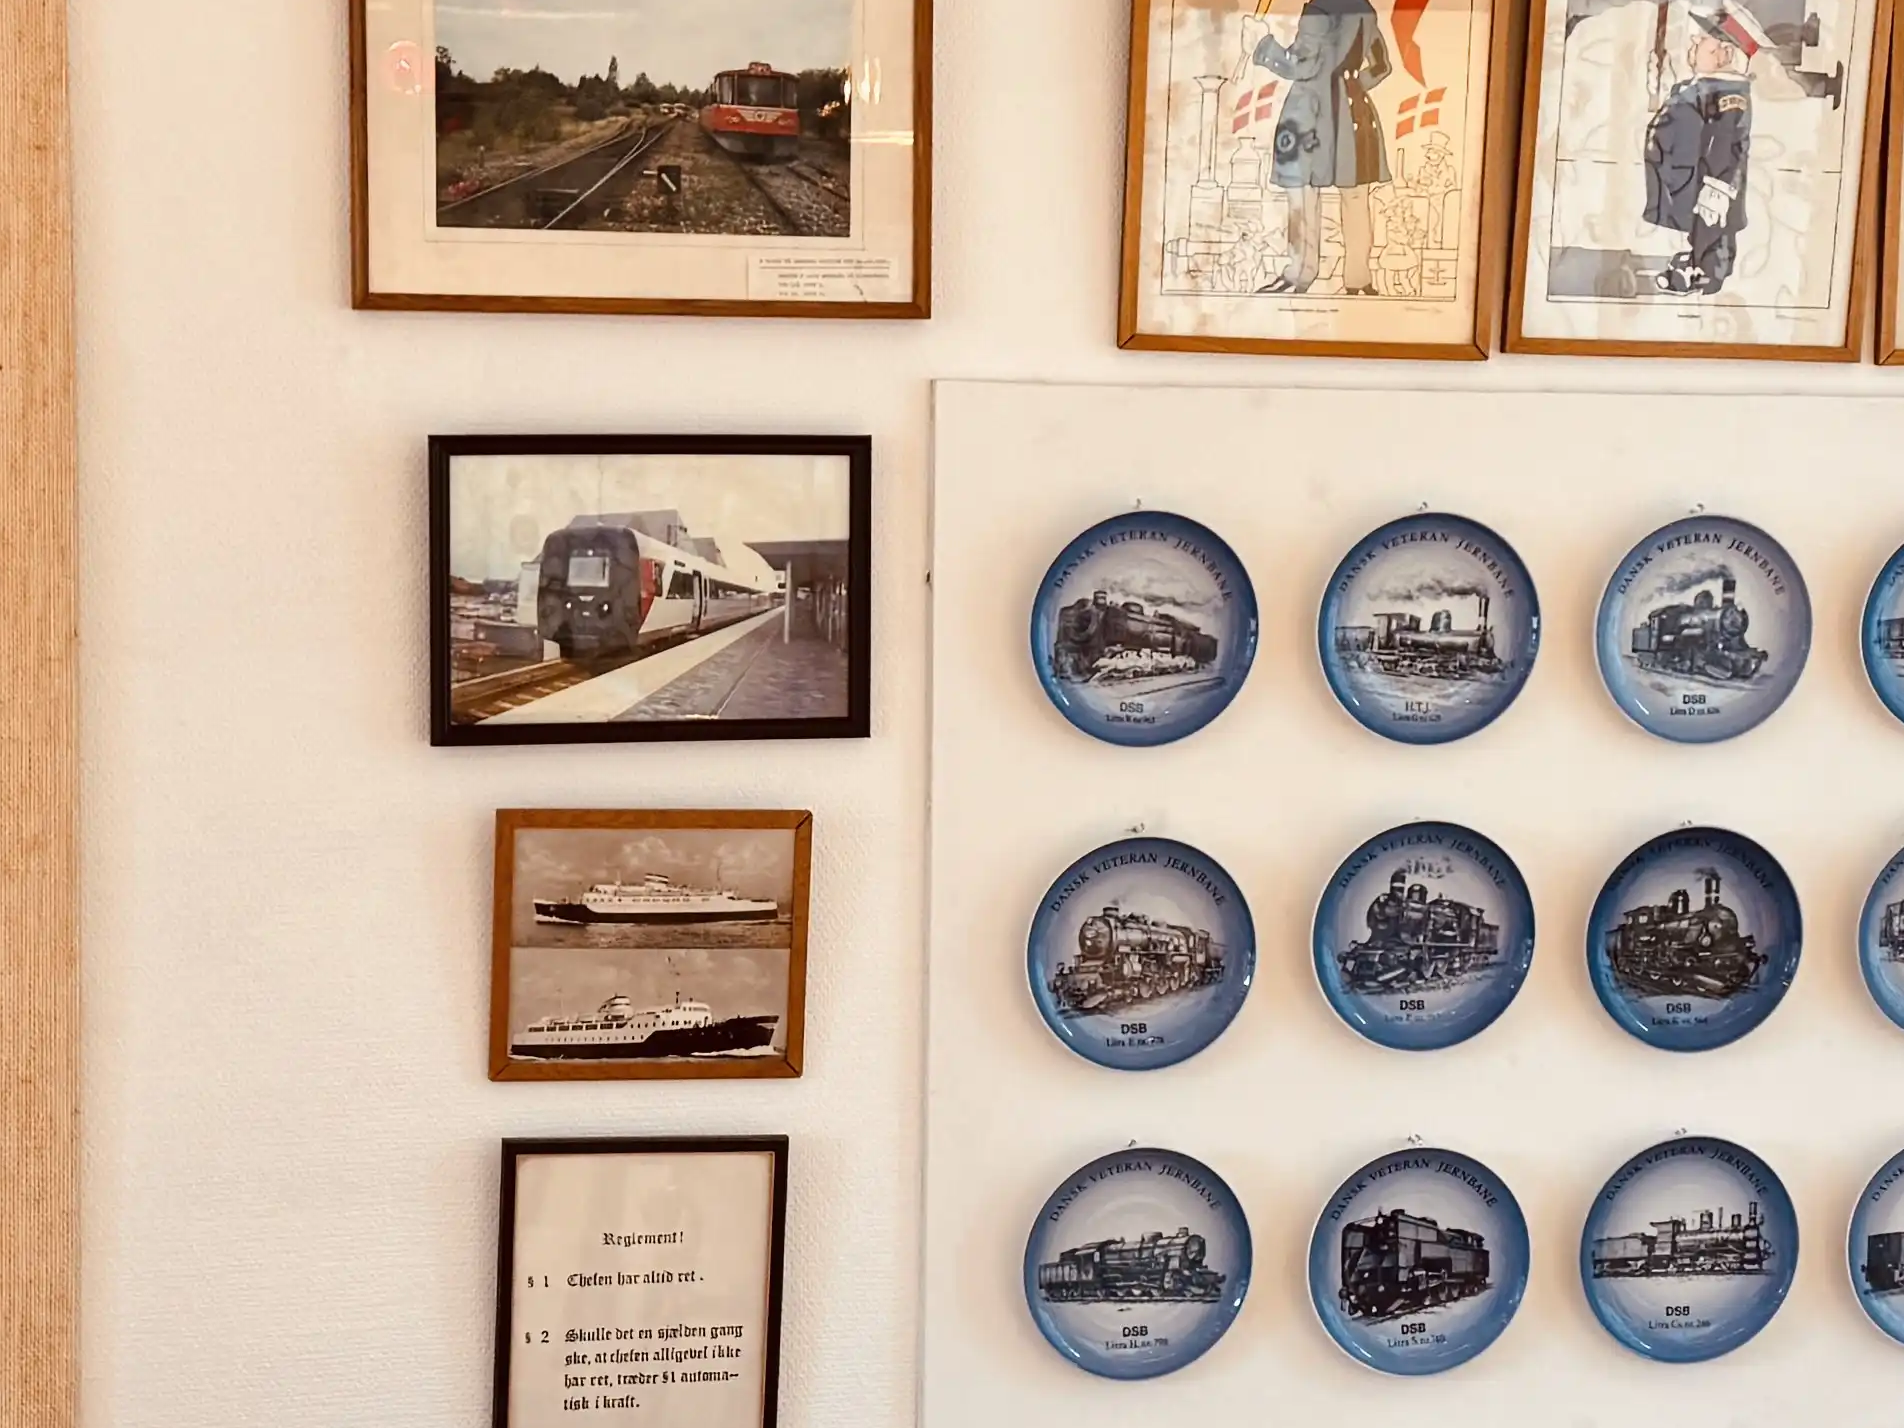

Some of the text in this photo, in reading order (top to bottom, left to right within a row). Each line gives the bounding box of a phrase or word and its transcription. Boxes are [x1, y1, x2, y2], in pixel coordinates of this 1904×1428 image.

[1683, 695, 1706, 704] DSB
[1120, 702, 1144, 713] DSB
[1052, 852, 1225, 912] DANSK VETERAN JERNBANE
[1400, 1000, 1424, 1010] DSB
[1666, 1003, 1691, 1014] DSB
[1121, 1024, 1147, 1034] DSB
[1332, 1158, 1499, 1221] DANSK VETERAN JERNBANE
[1050, 1185, 1088, 1222] DANSK
[544, 1276, 549, 1288] 1
[618, 1271, 640, 1286] har
[643, 1271, 674, 1284] altid
[1666, 1306, 1690, 1316] DSB
[541, 1331, 549, 1343] 2
[565, 1328, 612, 1343] Skulle
[616, 1328, 635, 1341] det
[638, 1328, 653, 1340] en
[658, 1325, 706, 1342] sjælden
[710, 1325, 743, 1339] gang
[1123, 1326, 1148, 1337] DSB
[1401, 1323, 1426, 1335] DSB
[565, 1352, 592, 1367] ske,
[595, 1352, 607, 1363] at
[653, 1346, 708, 1363] alligevel
[712, 1345, 742, 1360] ikke
[565, 1374, 586, 1388] har
[590, 1374, 613, 1388] ret,
[617, 1371, 658, 1386] træder
[564, 1395, 640, 1411] tisk i kraft.
